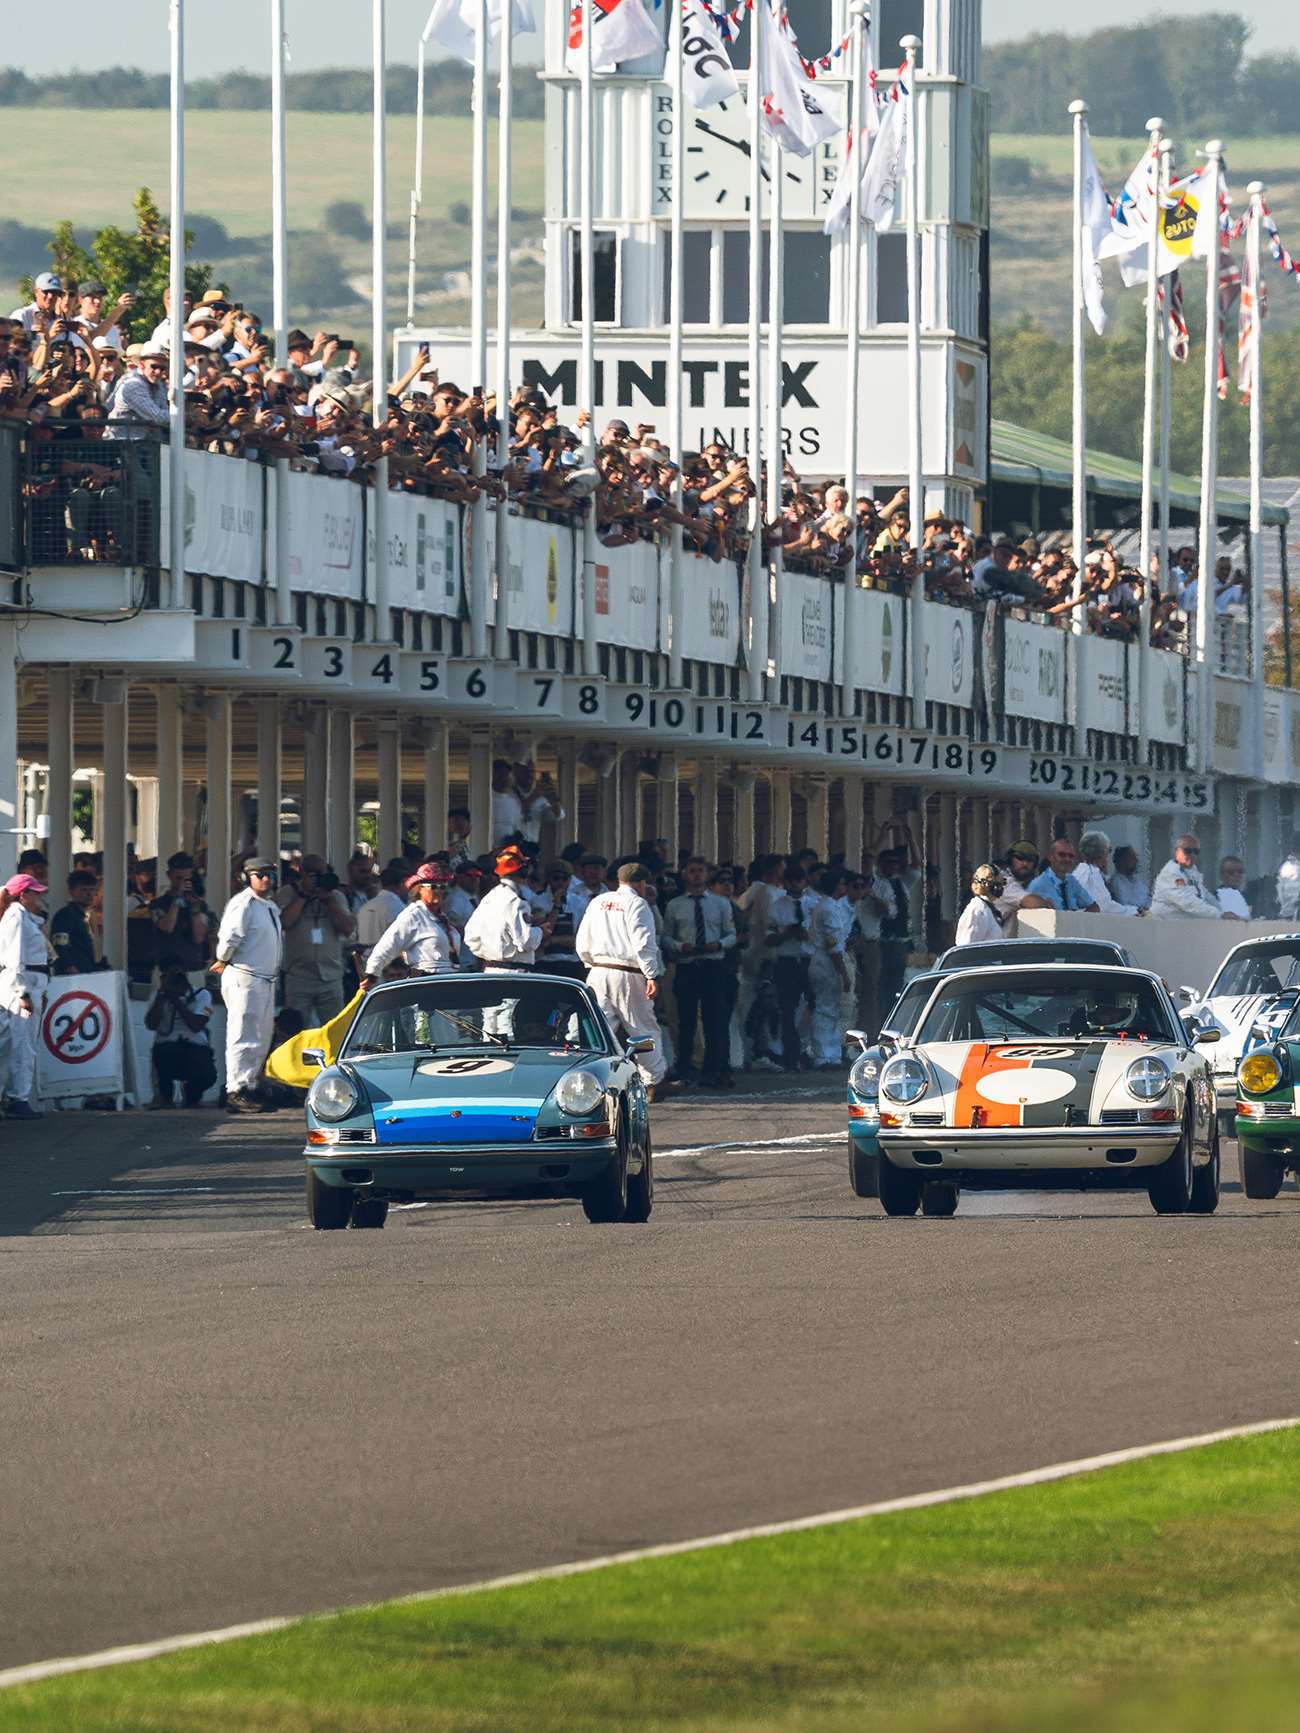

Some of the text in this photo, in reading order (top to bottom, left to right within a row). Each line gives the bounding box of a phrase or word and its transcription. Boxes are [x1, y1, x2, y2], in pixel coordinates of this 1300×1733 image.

[656, 96, 673, 202] ROLEX
[820, 142, 838, 204] LEX
[522, 359, 820, 408] MINTEX
[232, 629, 239, 660] 1
[273, 638, 295, 668] 2
[323, 647, 343, 677] 3
[371, 654, 393, 684] 4
[420, 661, 440, 691] 5
[466, 668, 487, 698] 6
[534, 678, 553, 707] 7
[579, 685, 599, 714] 8
[625, 693, 644, 722] 9
[650, 699, 684, 728] 10
[696, 706, 724, 733] 11
[731, 712, 763, 739] 12
[787, 721, 819, 748] 14
[826, 727, 858, 755] 15
[862, 733, 893, 760] 16
[897, 737, 928, 764] 17
[933, 743, 963, 770] 18
[967, 749, 997, 775] 19
[1061, 764, 1089, 791] 21
[1122, 774, 1151, 800] 23
[55, 1012, 100, 1044] 20
[437, 1060, 494, 1074] 9
